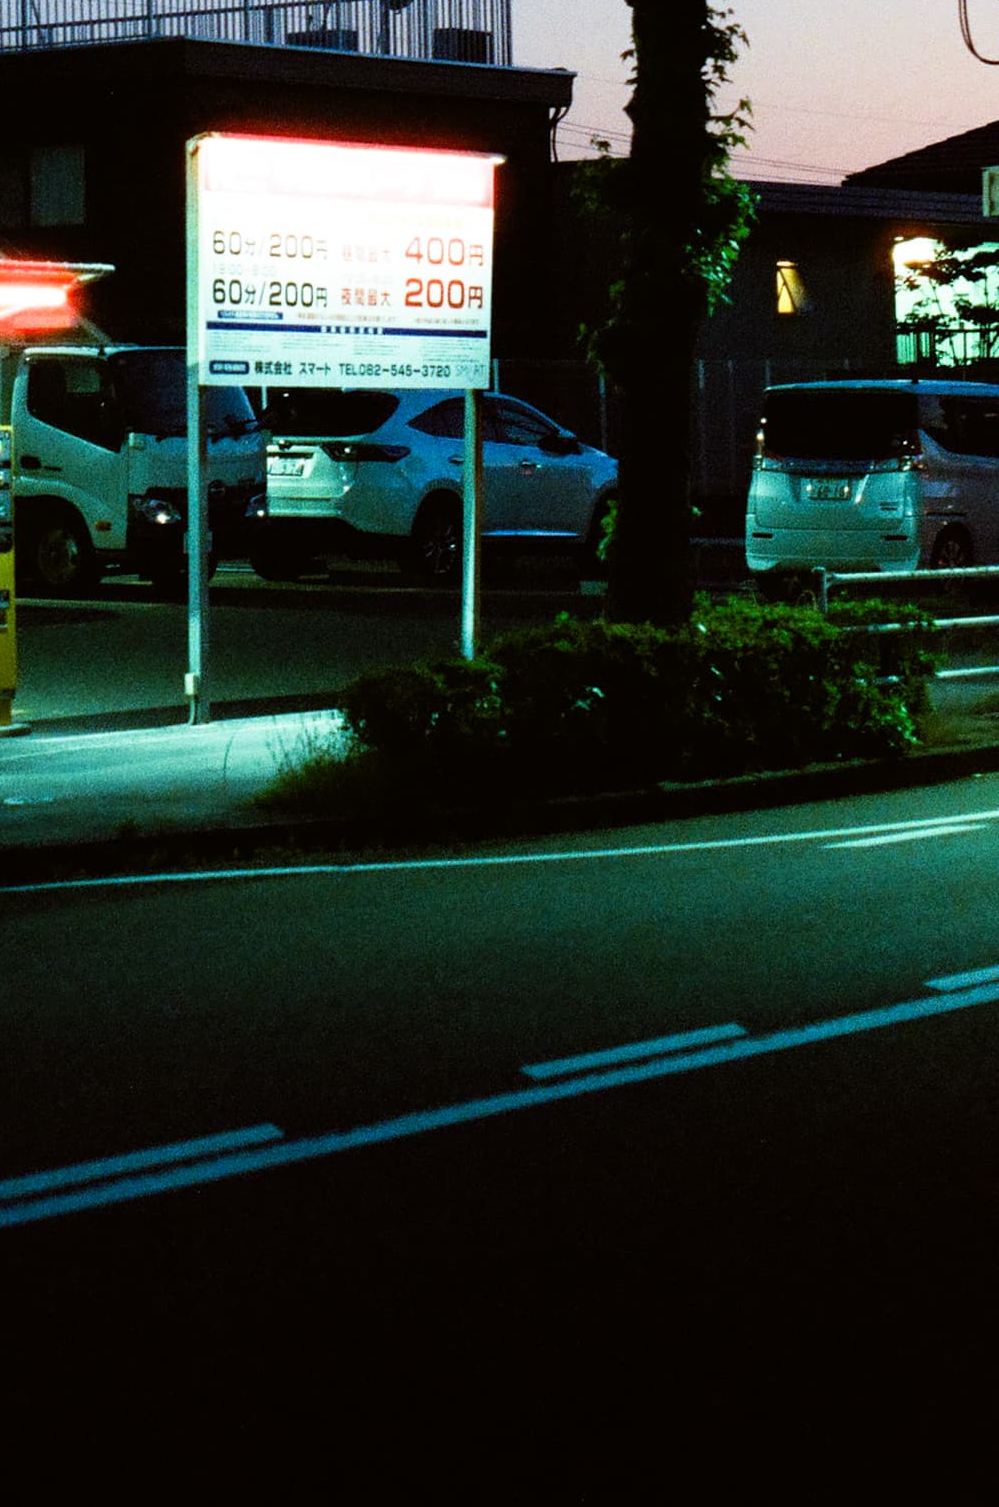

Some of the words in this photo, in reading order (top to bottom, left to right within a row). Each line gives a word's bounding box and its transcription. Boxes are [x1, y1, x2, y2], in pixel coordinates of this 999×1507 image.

[404, 236, 484, 267] 400円
[212, 278, 329, 308] 60分/200円
[404, 278, 484, 309] 200円
[254, 360, 292, 375] 株式会社
[299, 362, 331, 376] スマート
